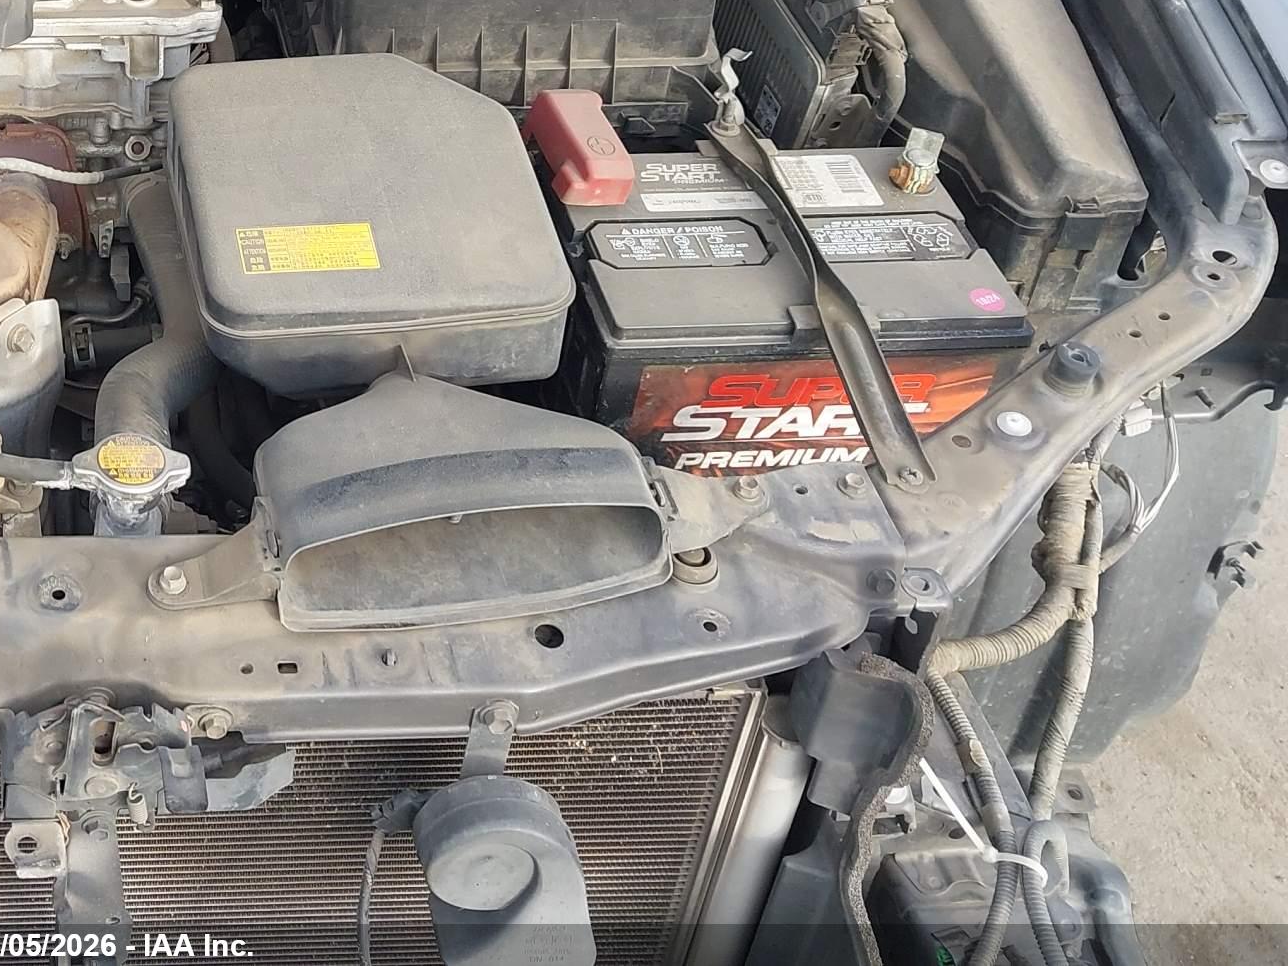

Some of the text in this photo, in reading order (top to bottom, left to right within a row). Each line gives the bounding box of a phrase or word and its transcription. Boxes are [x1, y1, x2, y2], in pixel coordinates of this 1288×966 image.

[646, 163, 718, 172] SUPER
[640, 171, 721, 182] START
[632, 227, 675, 235] DANGER
[684, 225, 724, 234] POISON
[700, 374, 937, 408] SUPR
[674, 446, 872, 470] PREMIUM
